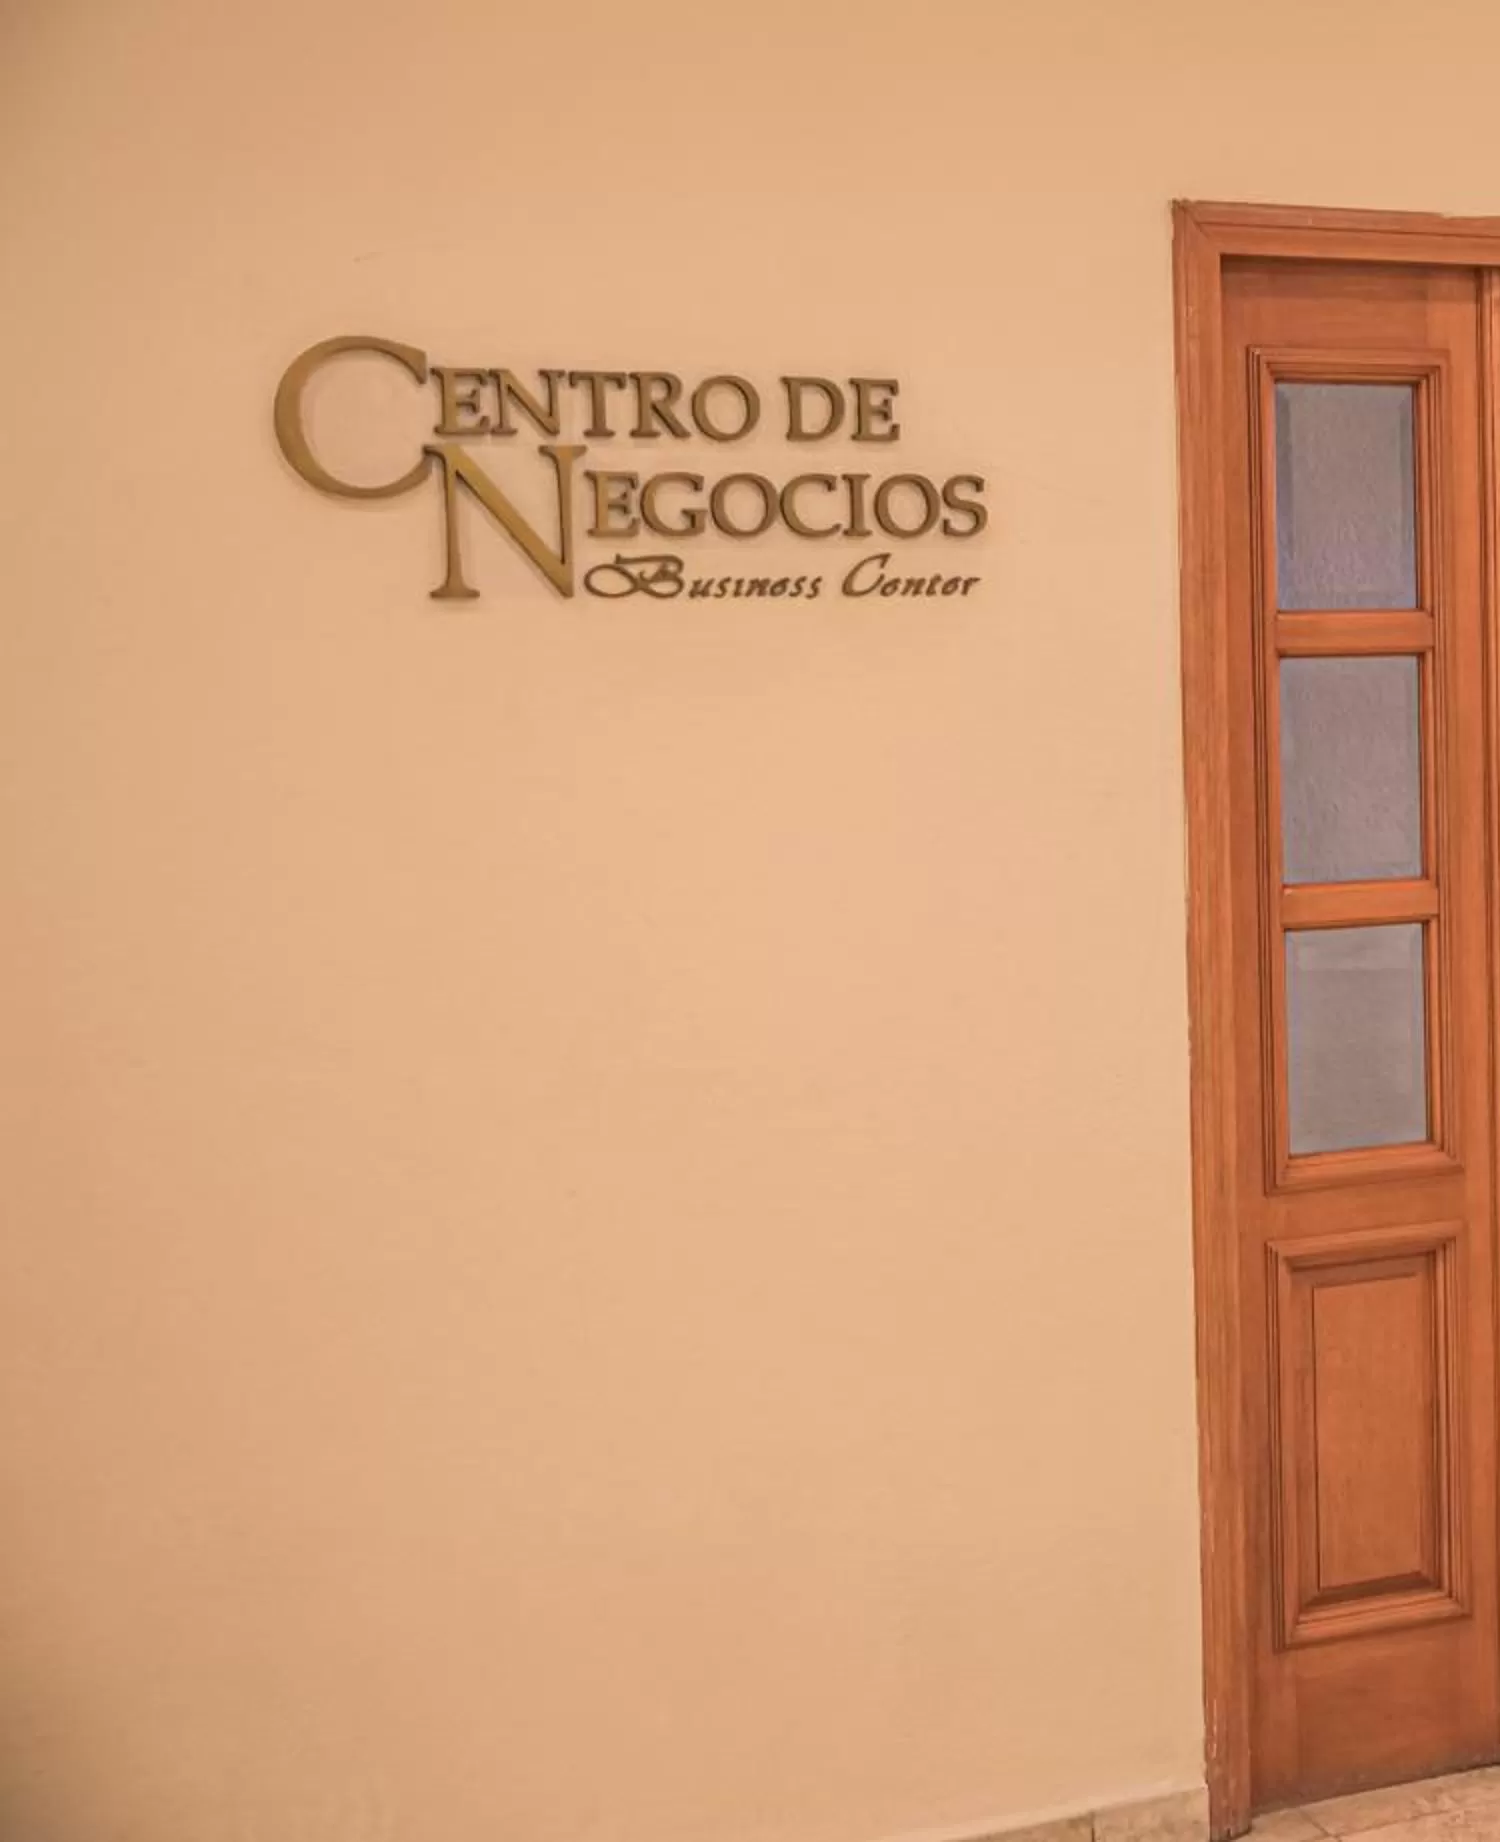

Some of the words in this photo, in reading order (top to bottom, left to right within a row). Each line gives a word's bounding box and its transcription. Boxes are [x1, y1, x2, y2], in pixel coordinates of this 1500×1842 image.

[274, 335, 761, 500] CENTRO
[780, 375, 901, 443] DE
[423, 444, 990, 600] NEGOCIOS
[841, 551, 981, 598] Center
